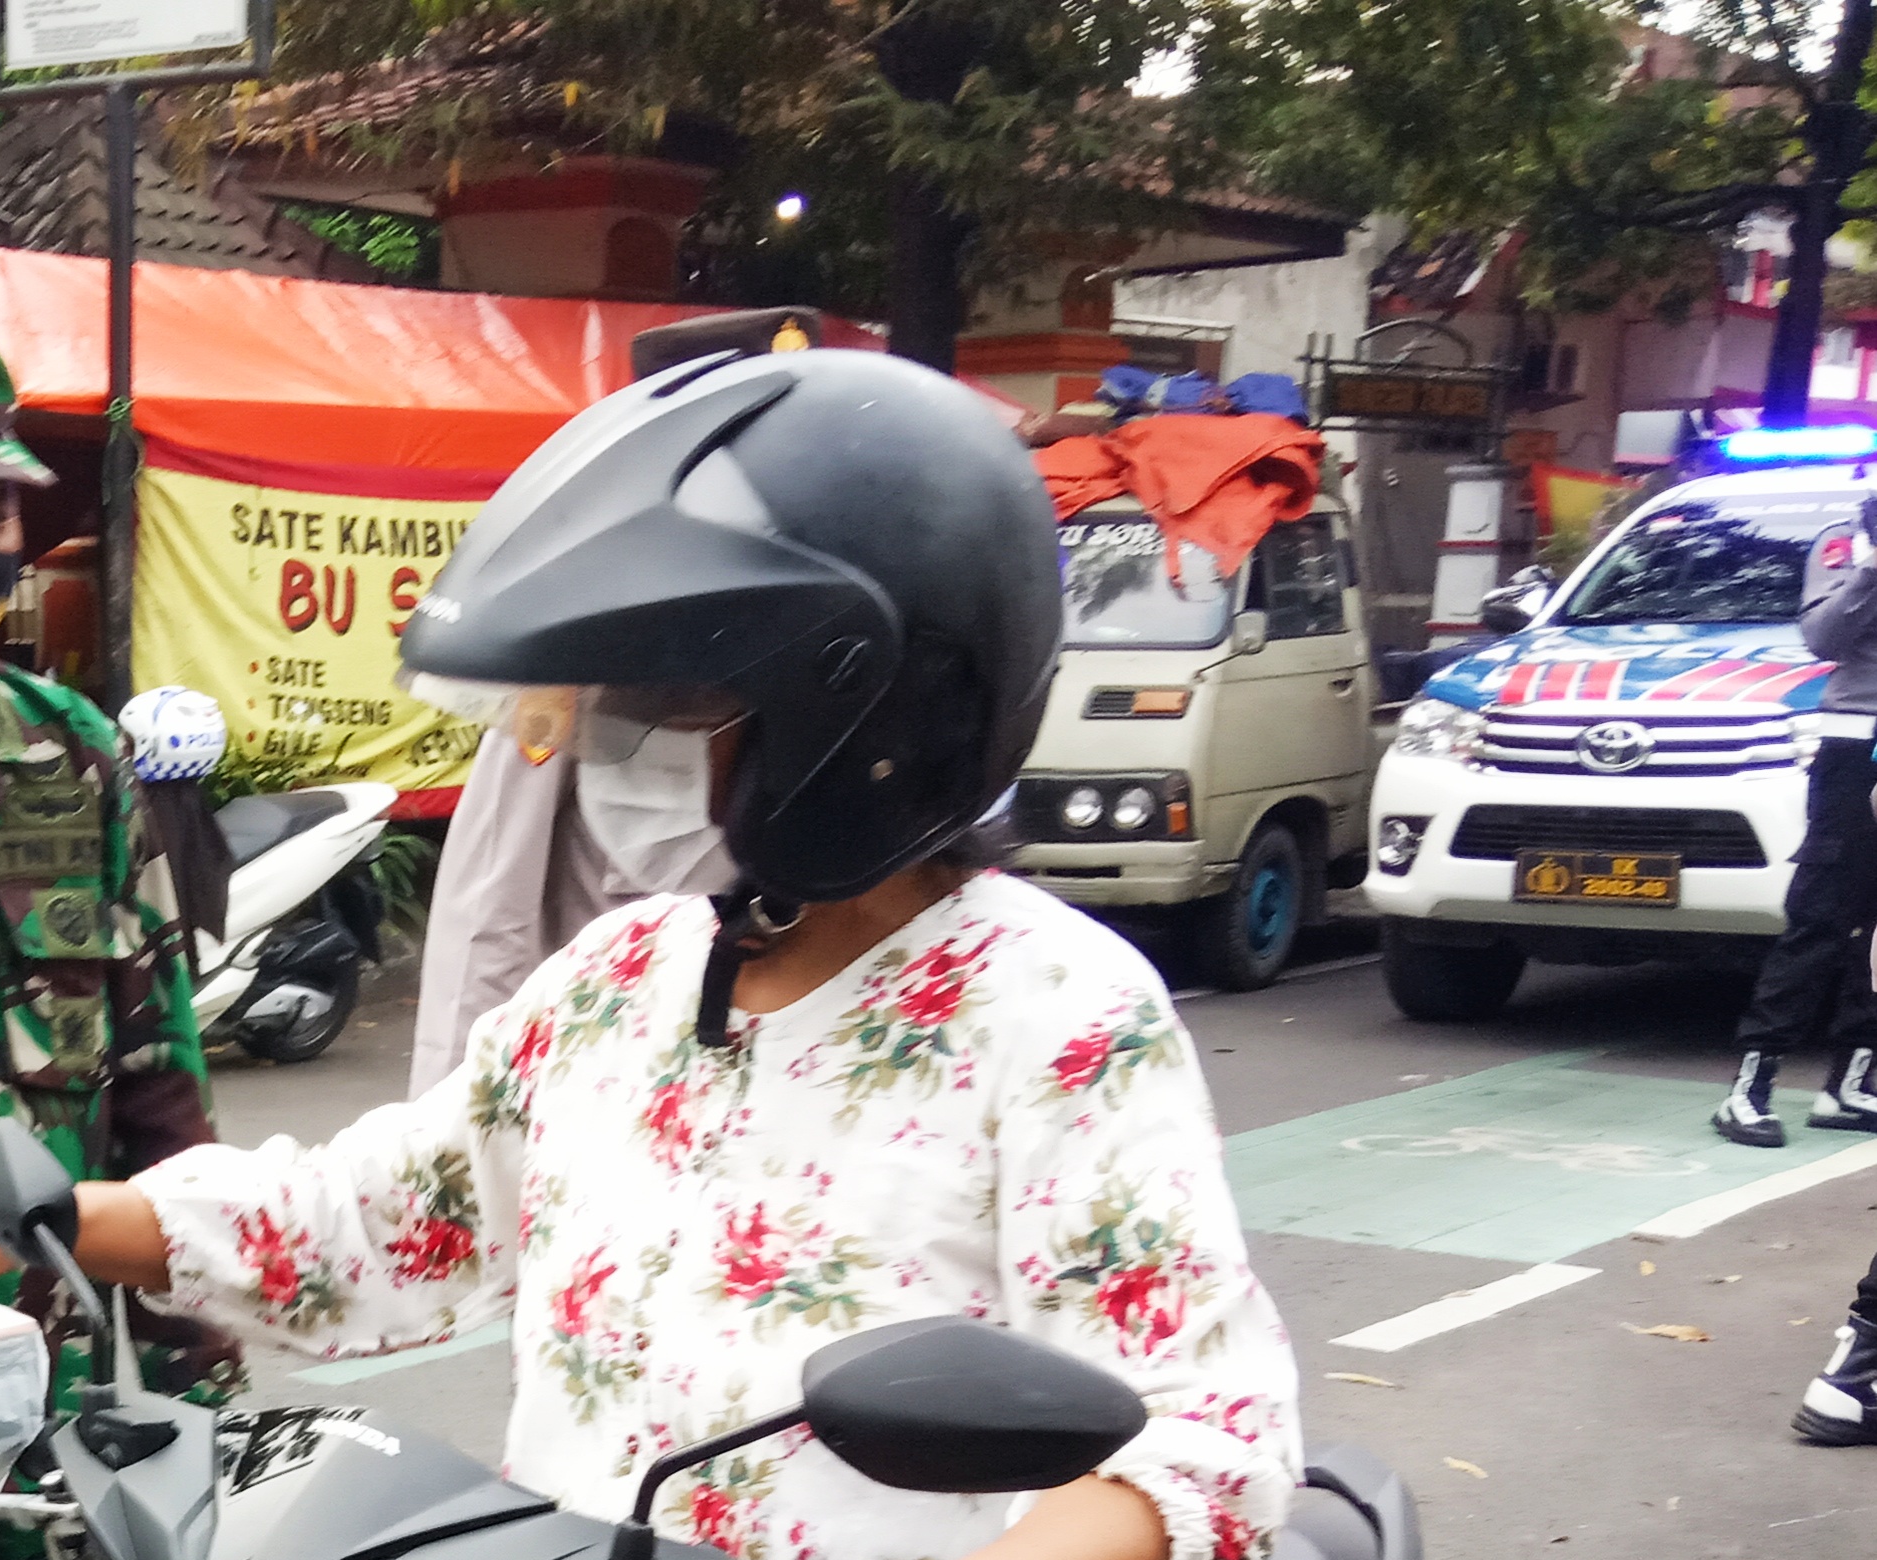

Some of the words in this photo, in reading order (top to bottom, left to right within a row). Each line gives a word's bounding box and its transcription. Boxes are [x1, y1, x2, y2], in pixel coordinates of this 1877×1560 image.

[230, 502, 325, 552] SATE
[278, 558, 357, 636] BU
[388, 566, 434, 638] S
[264, 655, 327, 688] SATE
